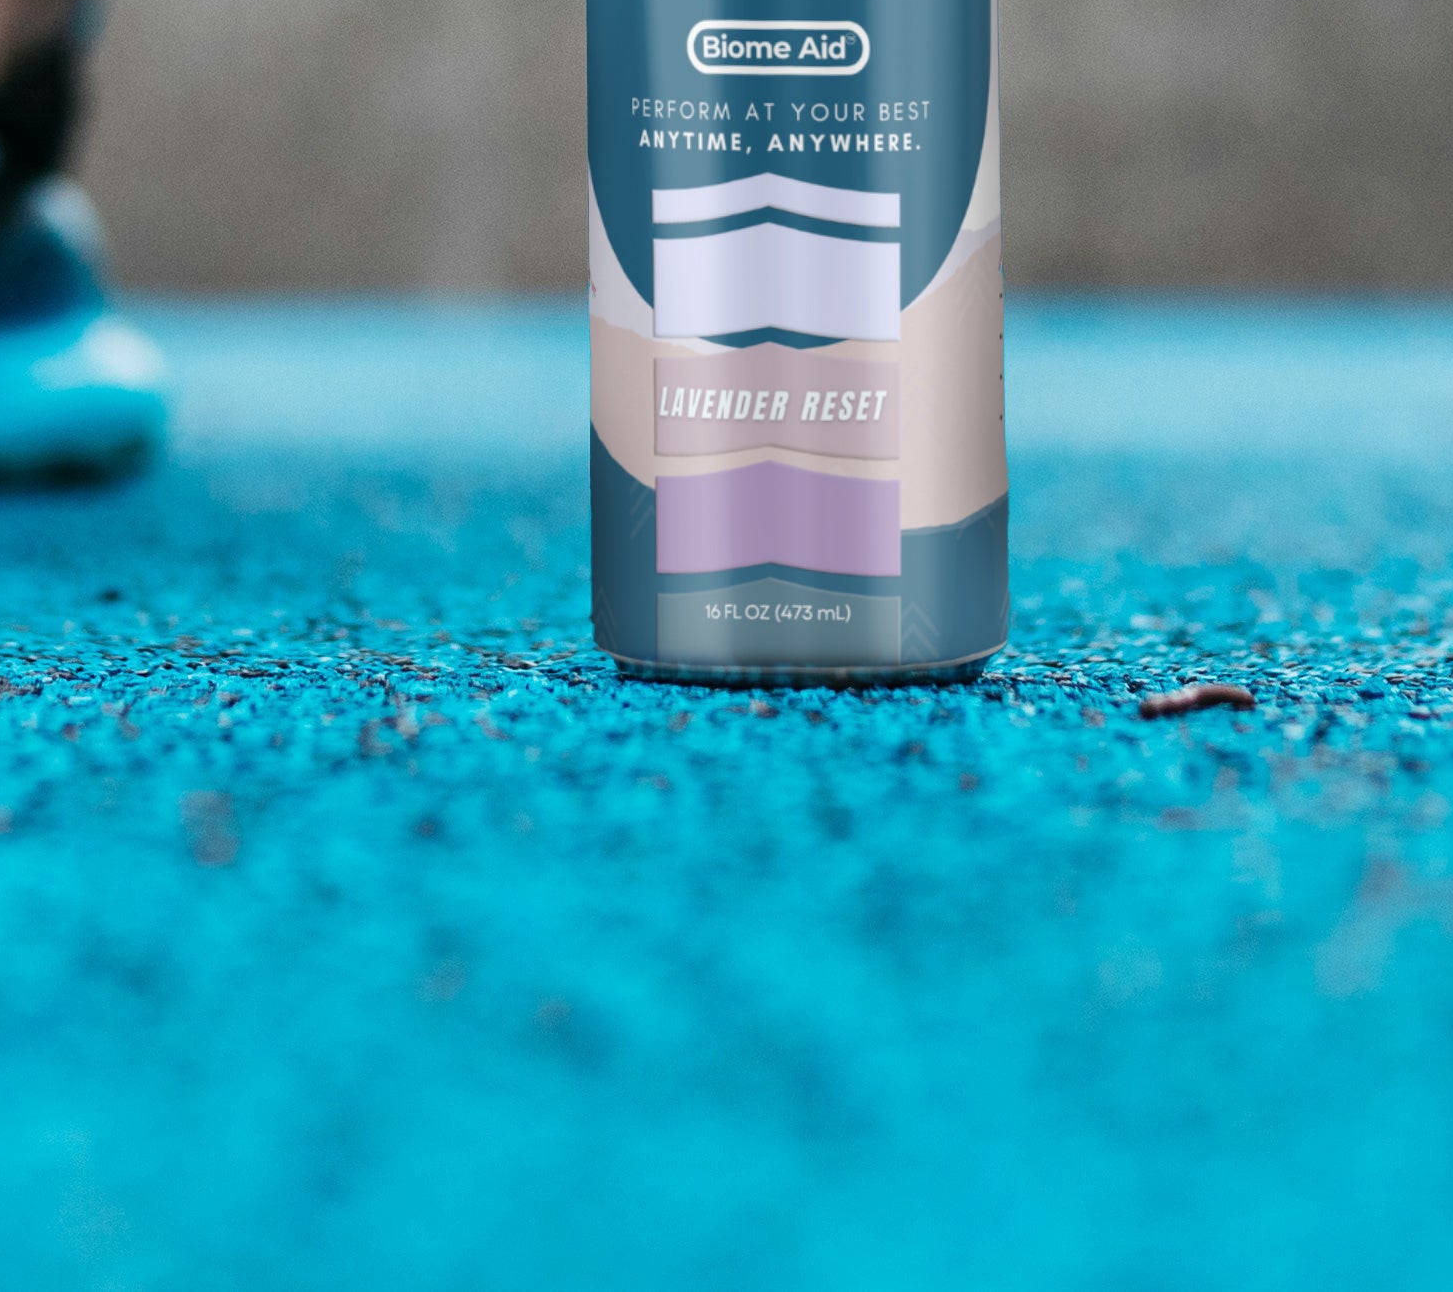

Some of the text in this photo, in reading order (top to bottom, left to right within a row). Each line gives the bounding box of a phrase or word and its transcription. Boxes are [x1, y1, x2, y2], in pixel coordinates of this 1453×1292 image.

[702, 33, 791, 59] Biome
[631, 97, 931, 122] PERFORM AT YOUR BEST
[639, 128, 921, 155] ANYTIME, ANYWHERE.
[659, 386, 888, 422] LAVENDER RESET
[705, 603, 852, 623] 16 FL OZ (473 mL)
